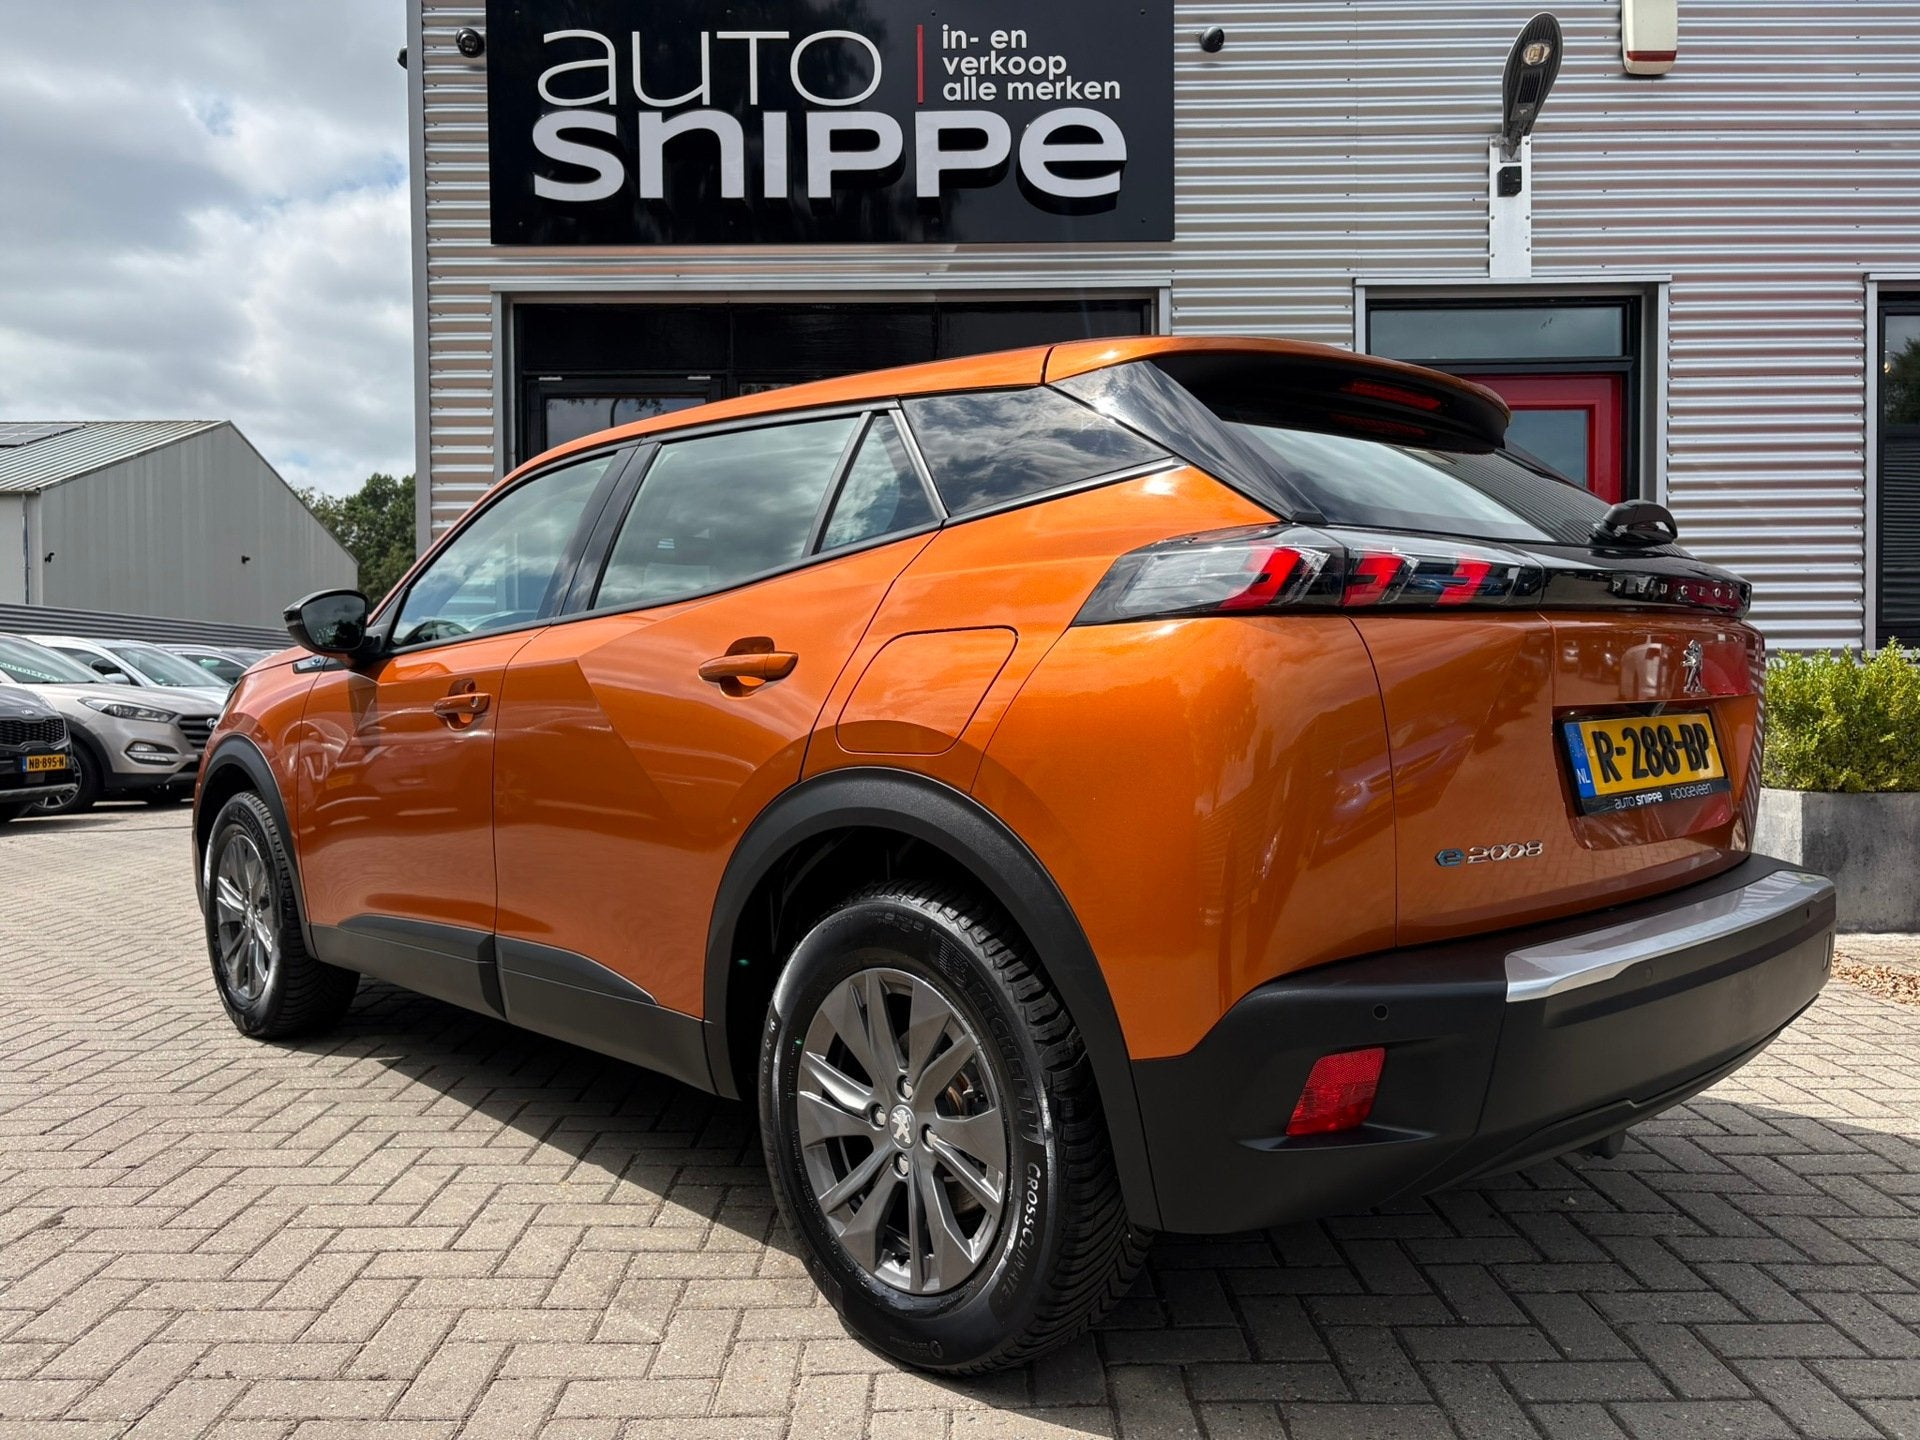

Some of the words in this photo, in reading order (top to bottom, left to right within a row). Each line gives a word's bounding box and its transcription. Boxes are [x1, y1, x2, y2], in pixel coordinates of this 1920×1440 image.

[941, 25, 979, 50] in-
[990, 29, 1027, 50] en
[942, 52, 1067, 80] verkoop
[942, 77, 1000, 102] alle
[1008, 77, 1121, 101] merken
[28, 756, 64, 769] NB-895-N
[1591, 723, 1709, 783] R-288-BP
[1576, 768, 1591, 784] NL
